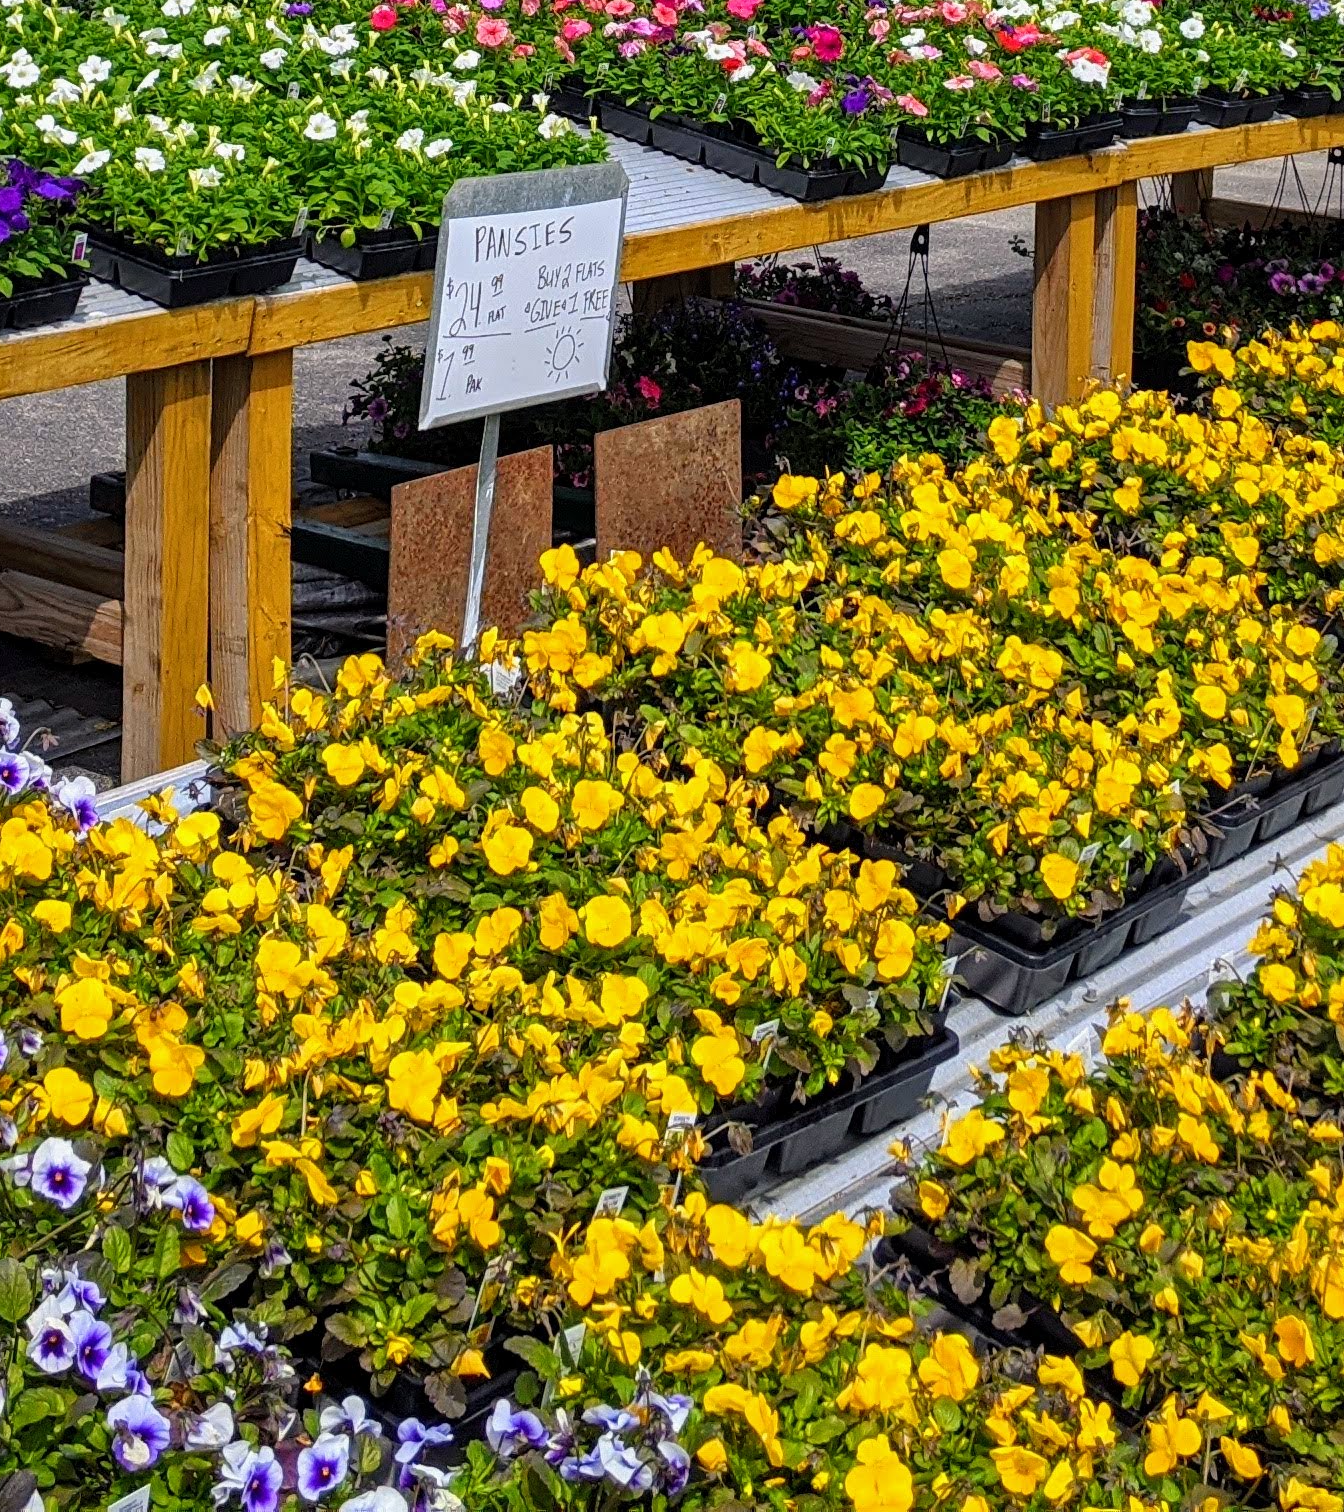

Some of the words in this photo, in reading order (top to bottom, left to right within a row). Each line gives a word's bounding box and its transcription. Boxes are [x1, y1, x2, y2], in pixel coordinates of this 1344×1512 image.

[474, 216, 576, 263] PANSIES
[537, 264, 562, 290] BUY
[561, 263, 572, 289] 2
[575, 260, 605, 284] FLATS
[487, 305, 507, 325] FLAT
